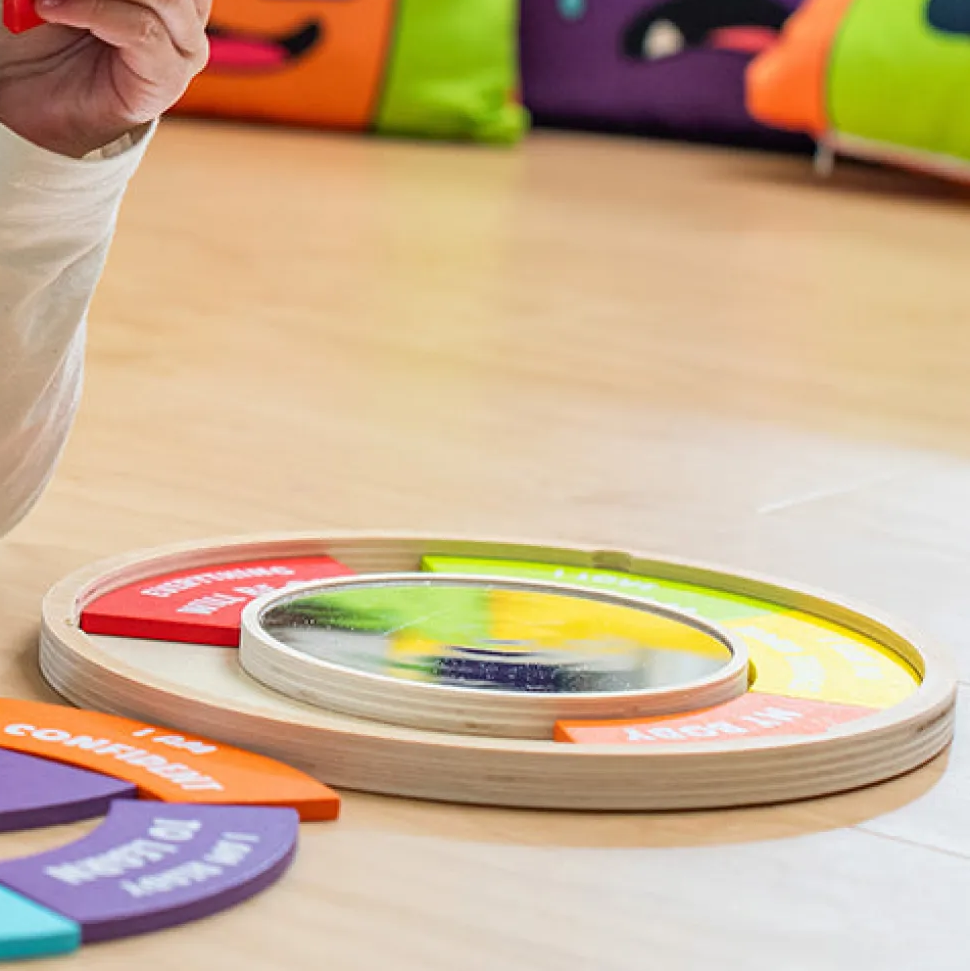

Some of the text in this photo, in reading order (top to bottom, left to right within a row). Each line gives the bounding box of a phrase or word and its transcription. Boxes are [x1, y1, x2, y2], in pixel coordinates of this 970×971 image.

[623, 706, 804, 741] MY BODY
[132, 727, 217, 755] I AM
[4, 723, 225, 792] CONFIDENT
[149, 818, 203, 841] TO
